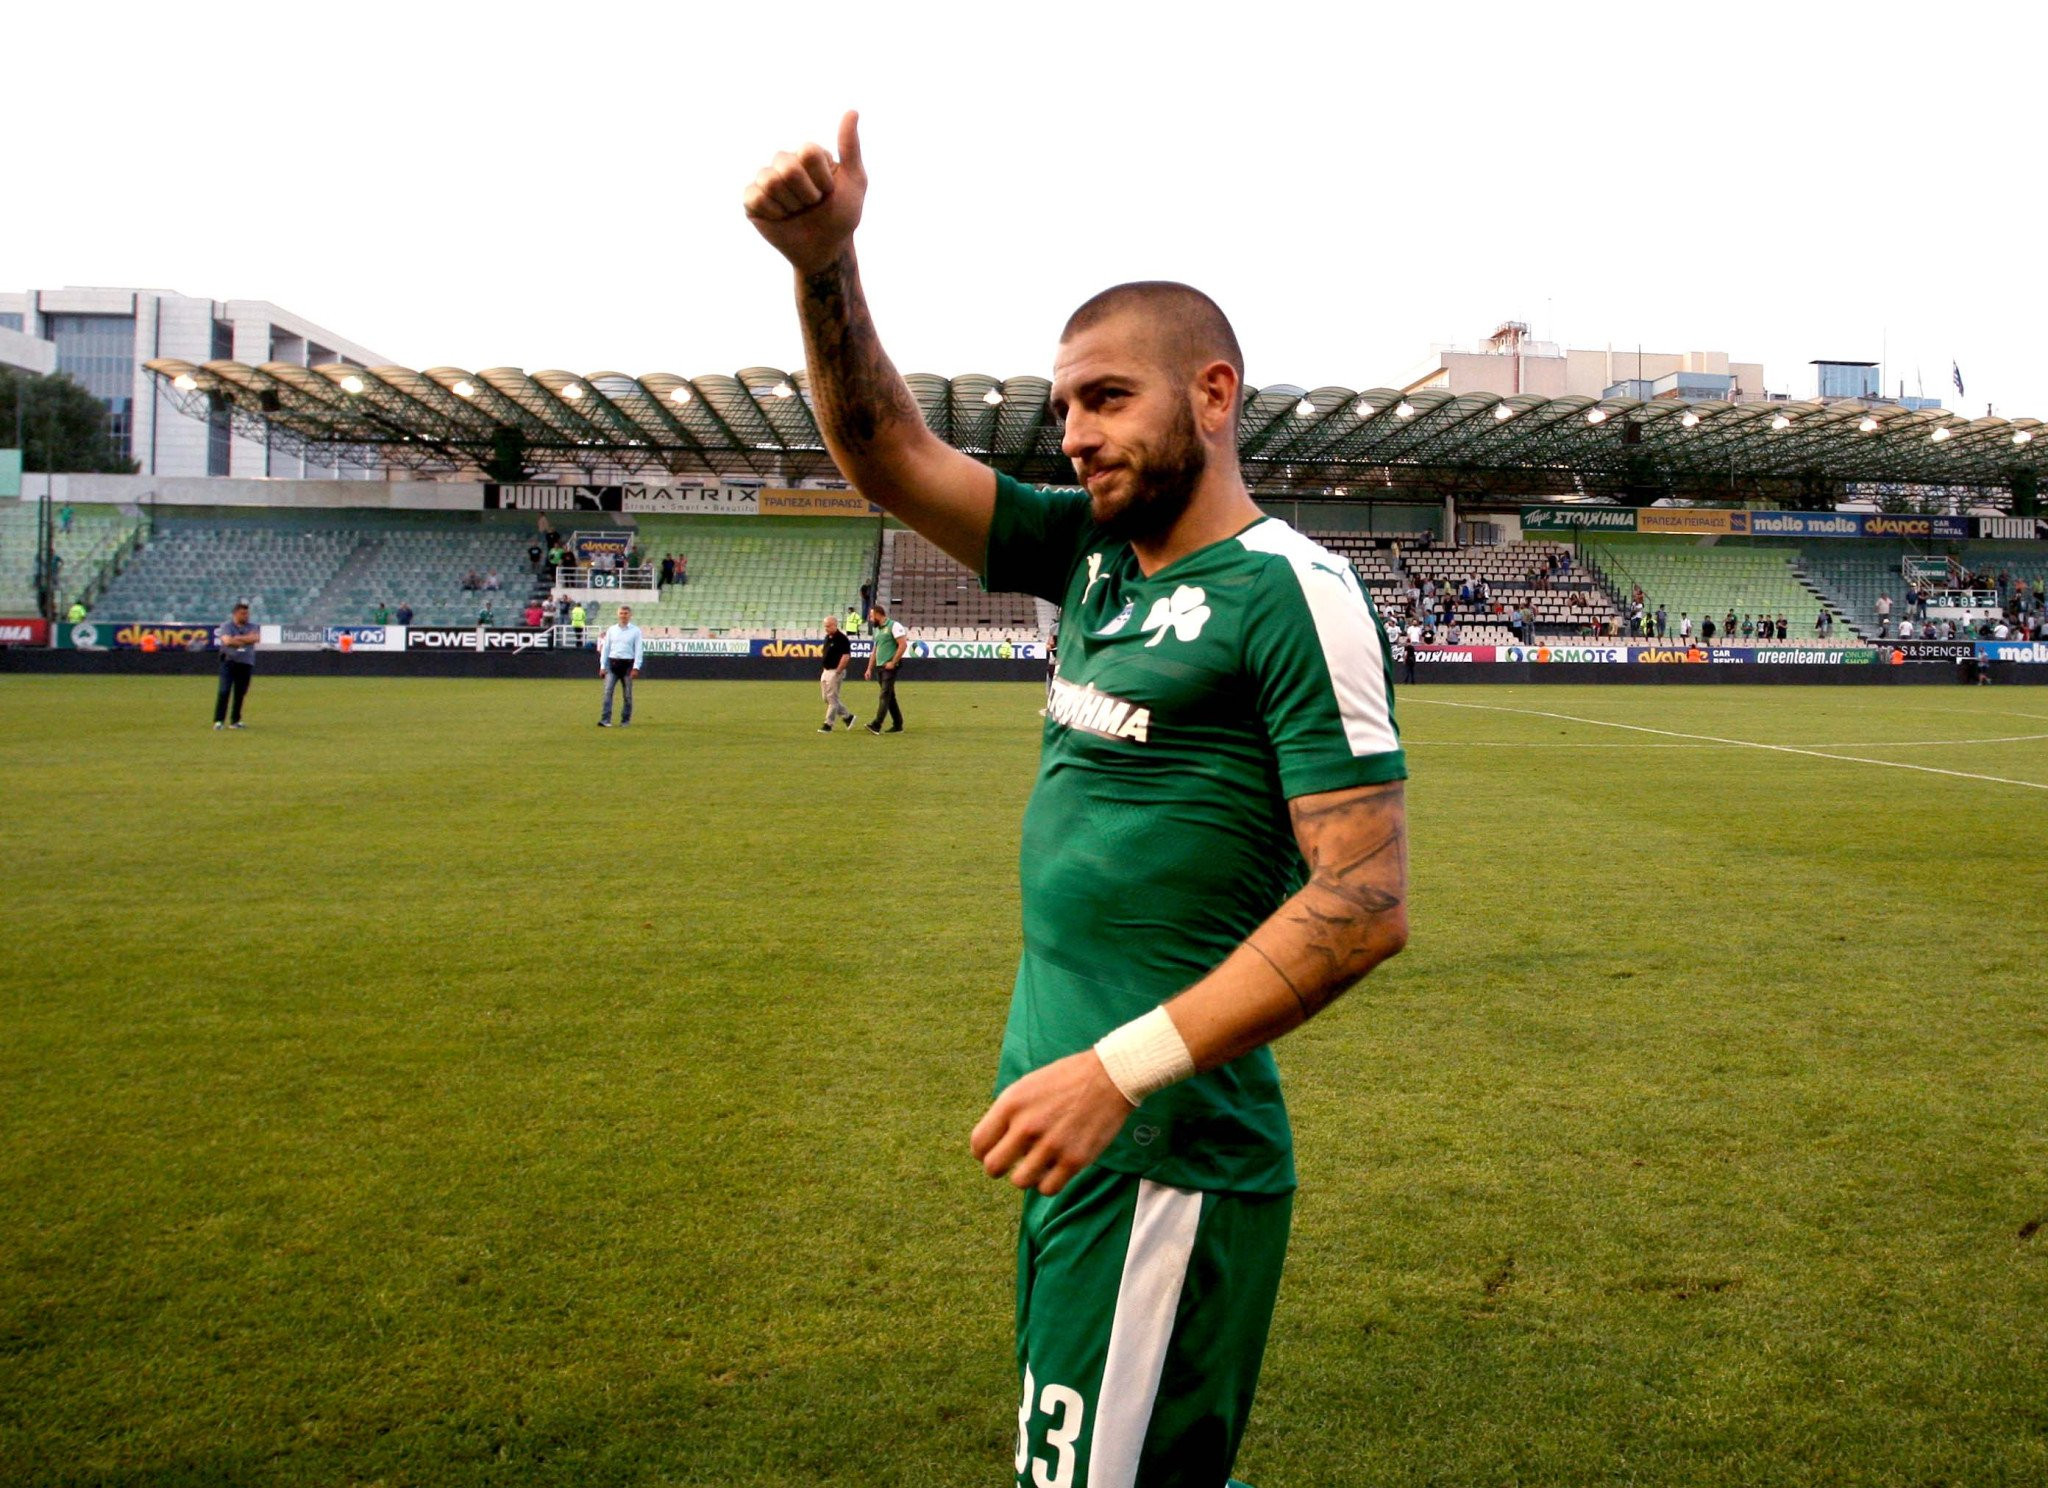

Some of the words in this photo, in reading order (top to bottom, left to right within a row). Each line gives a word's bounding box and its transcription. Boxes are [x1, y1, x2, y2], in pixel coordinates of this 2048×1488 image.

[500, 485, 574, 510] PUMA
[624, 487, 757, 502] MATRIX
[624, 503, 656, 512] Strong
[765, 497, 811, 508] ΤΡΑΠΕΖΑ
[814, 498, 862, 509] ΠΕΙΡΑΙΩΣ
[1641, 516, 1682, 526] ΤΡΑΠΕΖΑ
[1685, 517, 1724, 527] ΠΕΙΡΑΙΩΣ
[1754, 515, 1803, 532] molto
[1808, 517, 1857, 533] molto
[1933, 528, 1963, 536] RENTAL
[1980, 518, 2035, 539] PUMA
[283, 631, 322, 641] Human
[850, 642, 870, 650] CAR
[933, 644, 1035, 659] COSMTE
[1919, 646, 1970, 657] SPENCER
[1526, 649, 1617, 662] CSMOTE
